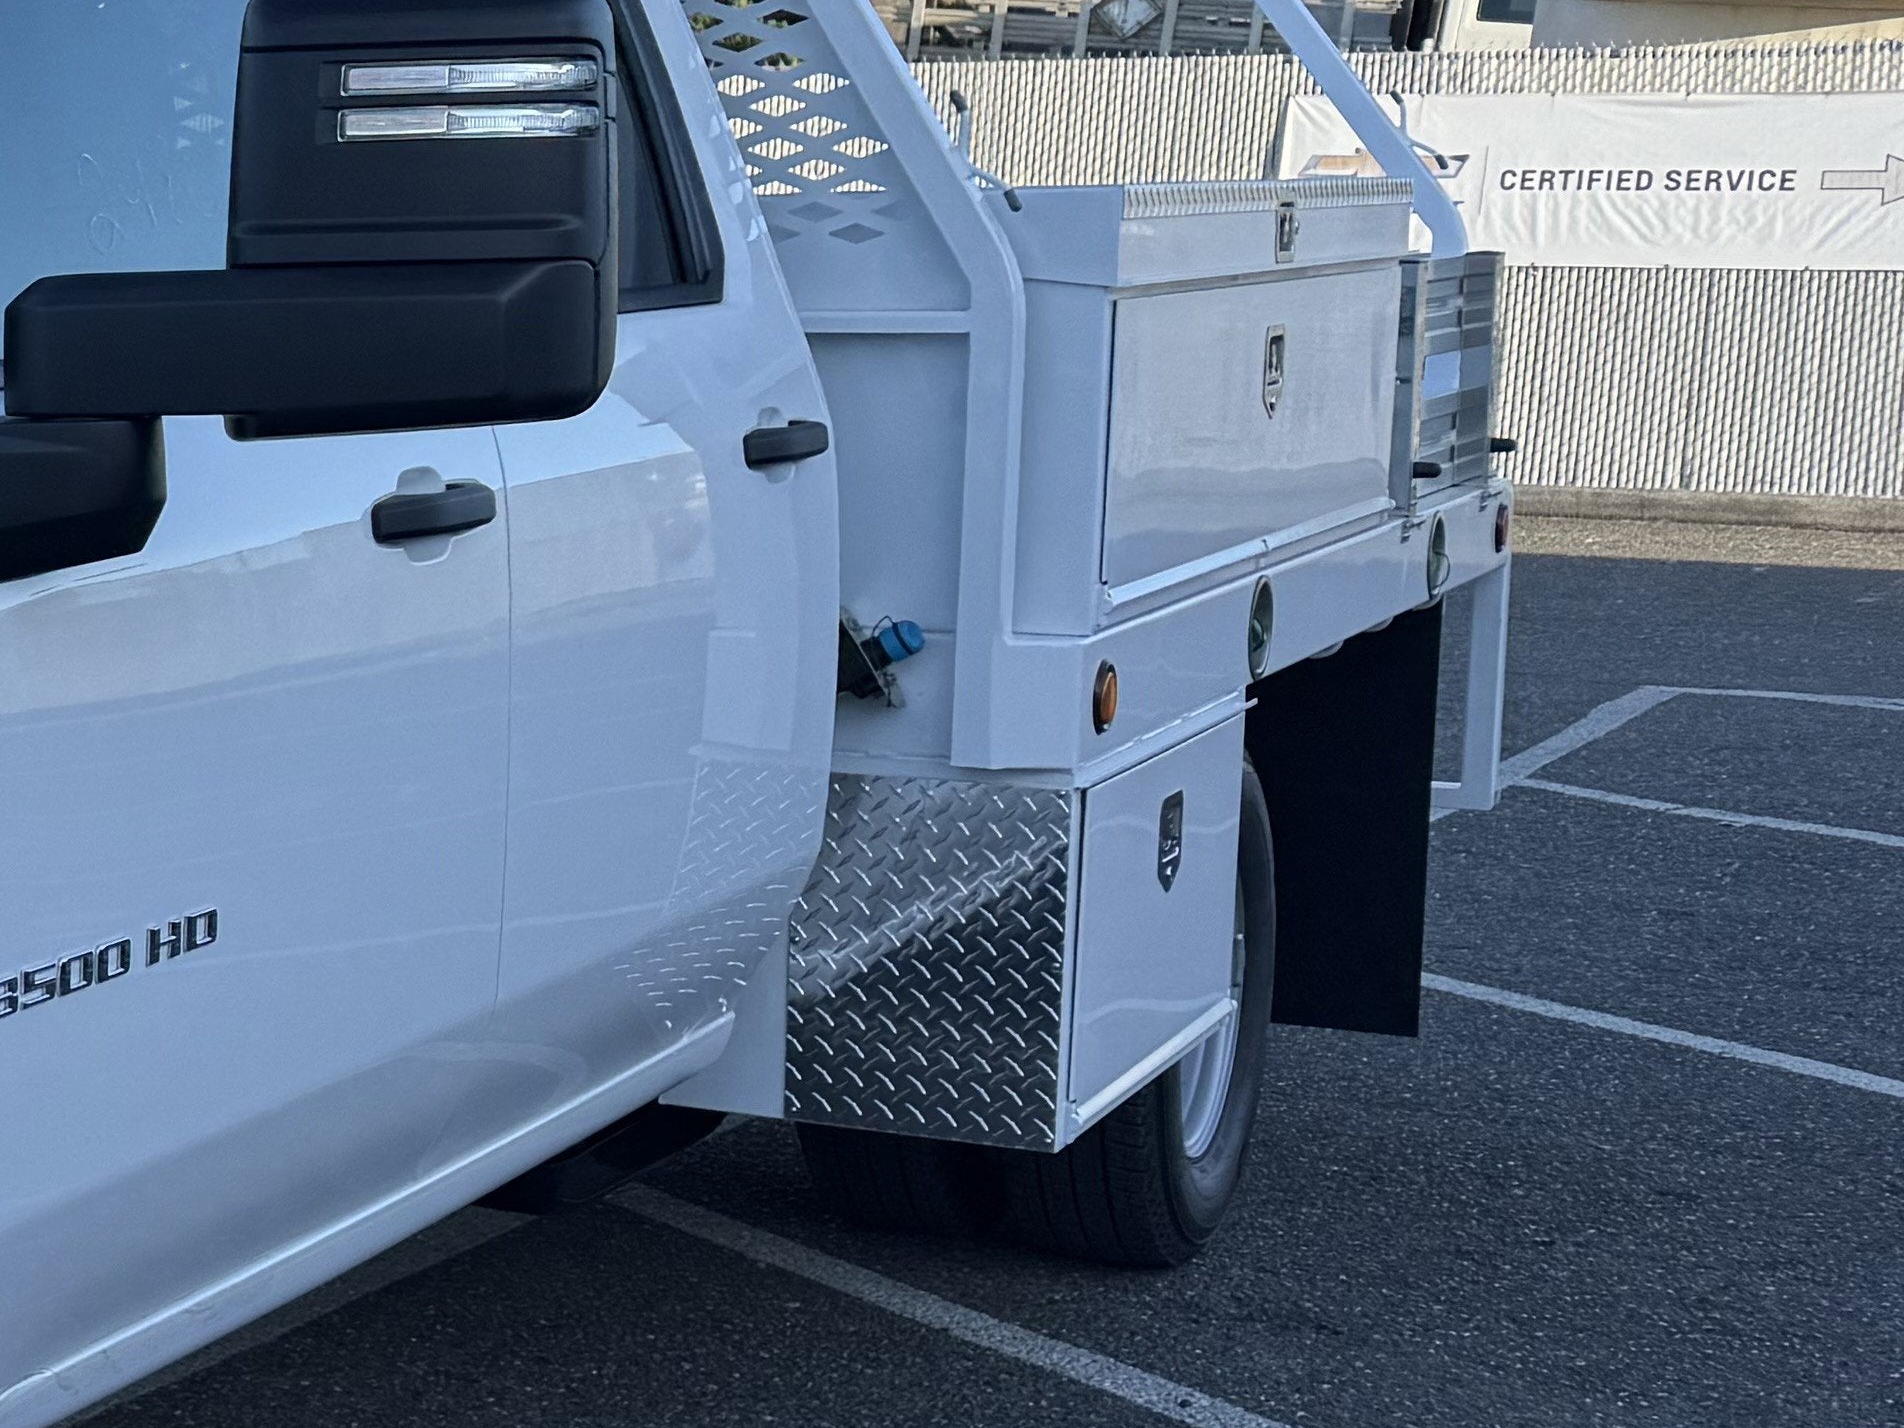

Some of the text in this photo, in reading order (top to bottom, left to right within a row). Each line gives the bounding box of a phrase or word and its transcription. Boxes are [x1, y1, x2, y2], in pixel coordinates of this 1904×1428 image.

[1499, 169, 1798, 192] CERTIFIED SERVICE
[145, 906, 218, 968] HD
